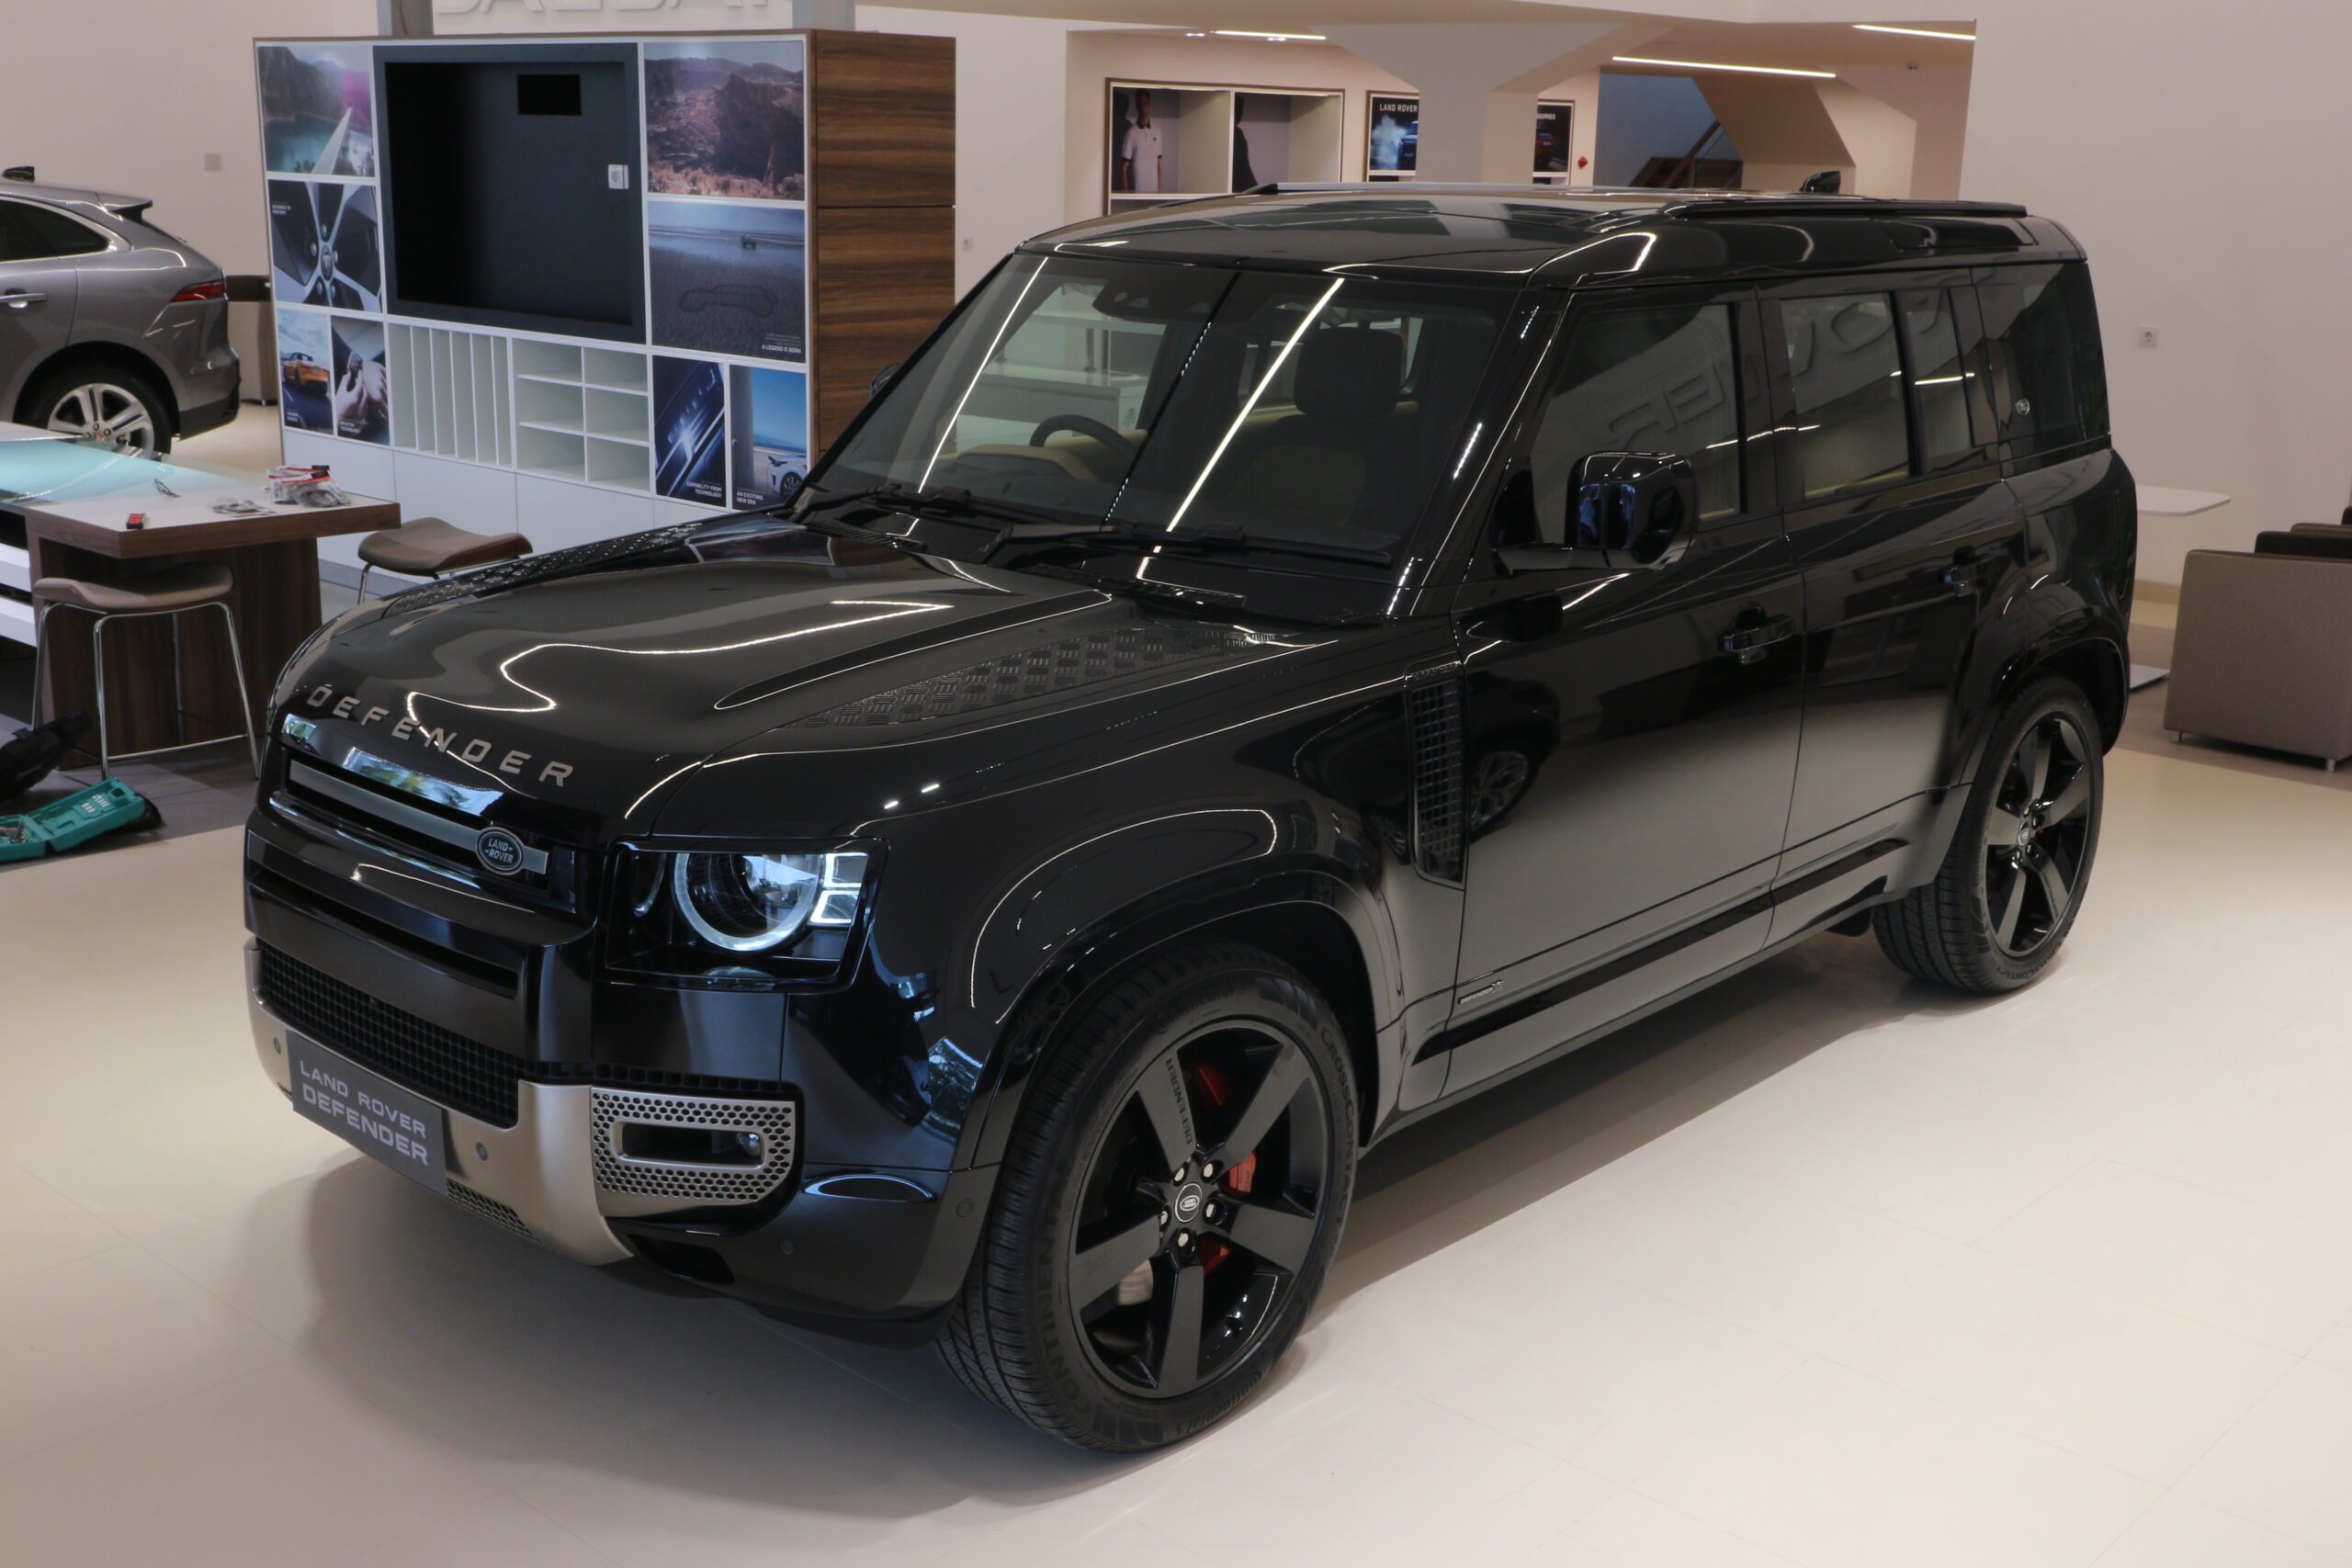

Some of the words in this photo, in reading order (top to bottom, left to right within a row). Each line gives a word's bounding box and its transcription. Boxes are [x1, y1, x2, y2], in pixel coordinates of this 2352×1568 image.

[1396, 104, 1418, 112] ROVER
[695, 489, 722, 498] TECHNOLOGY
[306, 685, 573, 787] DEFENDER
[300, 1060, 349, 1098] LAND
[358, 1091, 426, 1139] ROVER
[302, 1083, 429, 1166] DEFENDER
